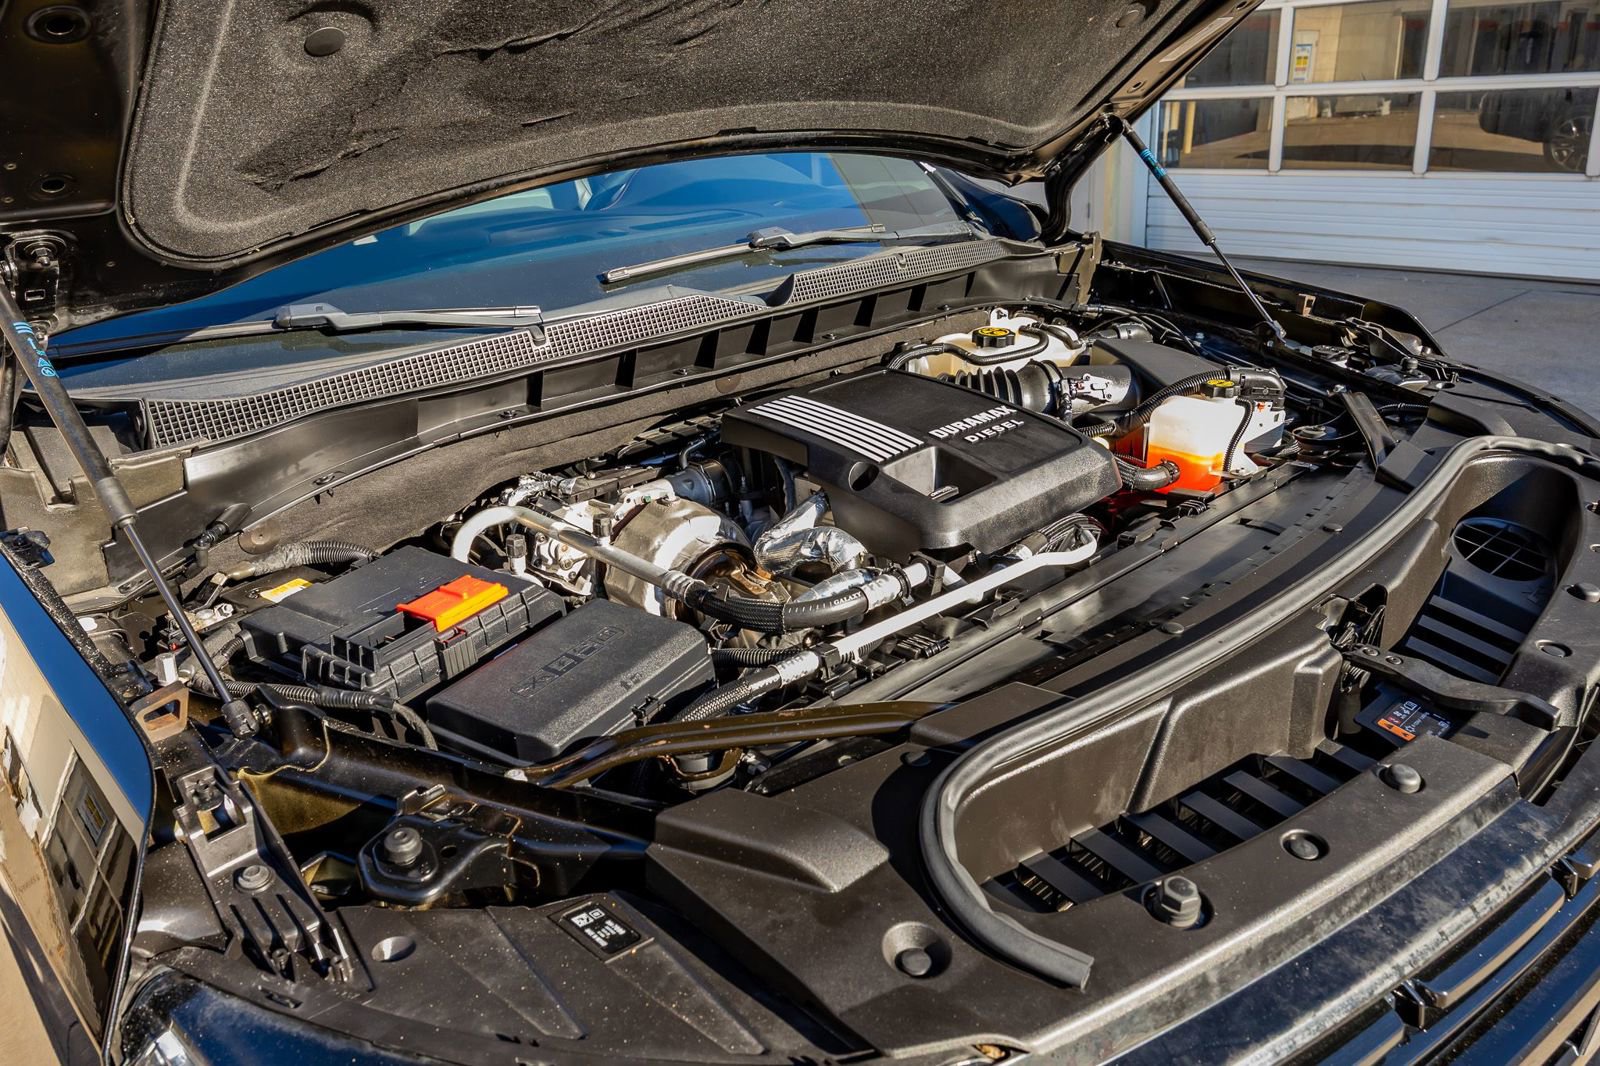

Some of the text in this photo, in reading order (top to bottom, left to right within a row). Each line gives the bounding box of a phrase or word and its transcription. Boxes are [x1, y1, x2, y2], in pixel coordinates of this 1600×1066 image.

[929, 405, 1018, 439] DURAMAX
[964, 419, 1025, 443] DIESEL
[833, 591, 862, 605] GALAXY
